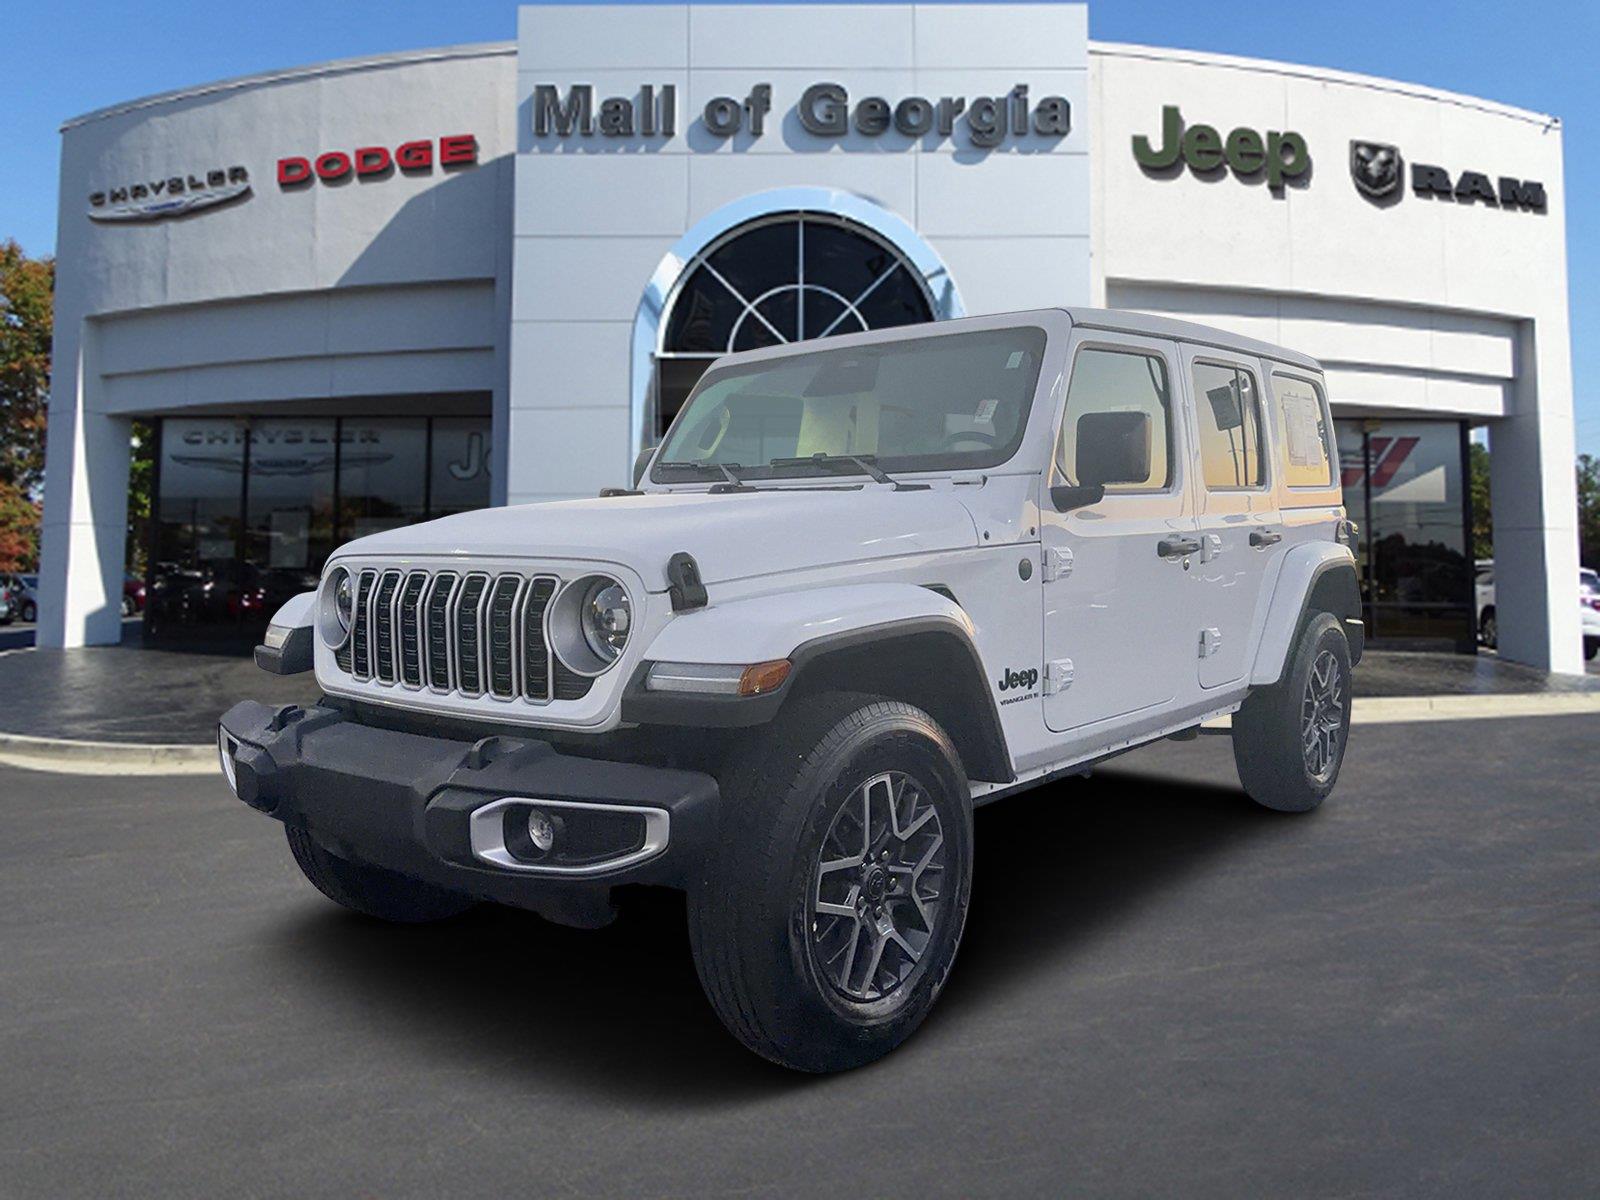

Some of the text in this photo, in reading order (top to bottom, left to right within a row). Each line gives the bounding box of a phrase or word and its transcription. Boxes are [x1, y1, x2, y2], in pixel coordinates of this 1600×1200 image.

[533, 83, 1072, 148] Mall of Georgia
[277, 134, 478, 188] DODGE
[1132, 105, 1309, 198] Jeep
[90, 166, 250, 206] CHRYSLER
[1410, 162, 1548, 214] RAM
[998, 667, 1038, 692] Jeep
